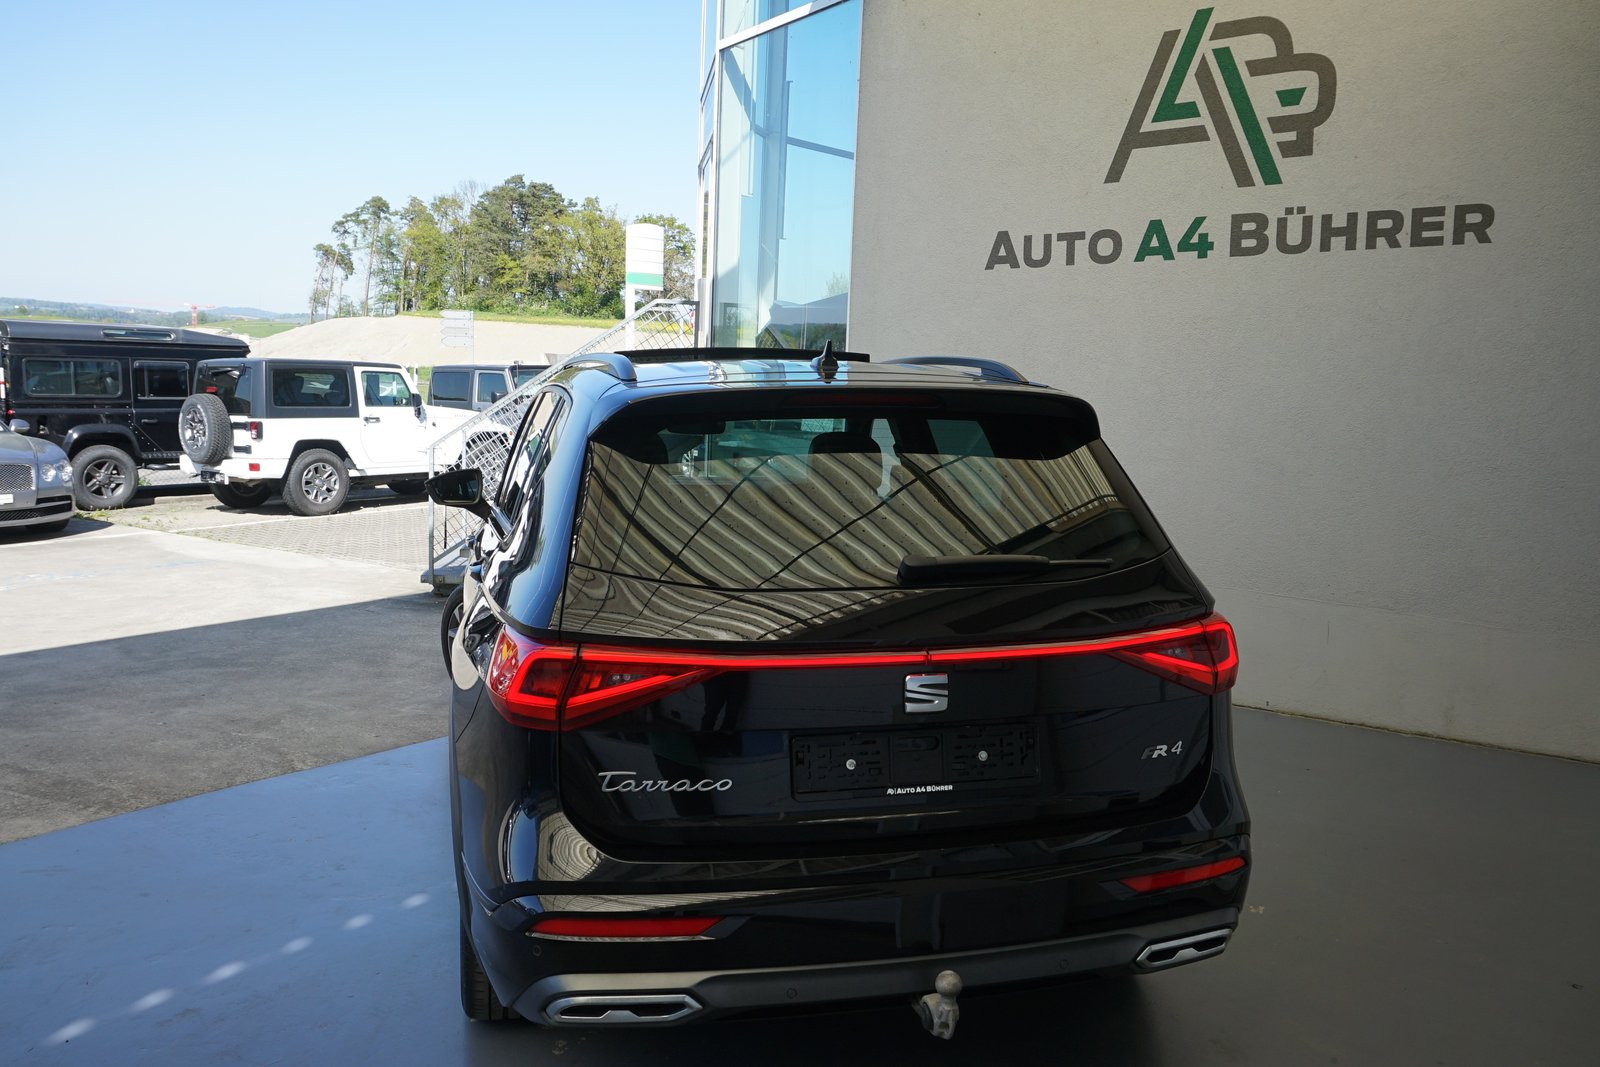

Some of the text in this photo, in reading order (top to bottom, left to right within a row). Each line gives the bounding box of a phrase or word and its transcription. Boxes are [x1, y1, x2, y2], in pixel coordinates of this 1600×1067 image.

[984, 203, 1496, 271] AUTO A4 BÜHRER
[598, 771, 733, 793] Tarraco
